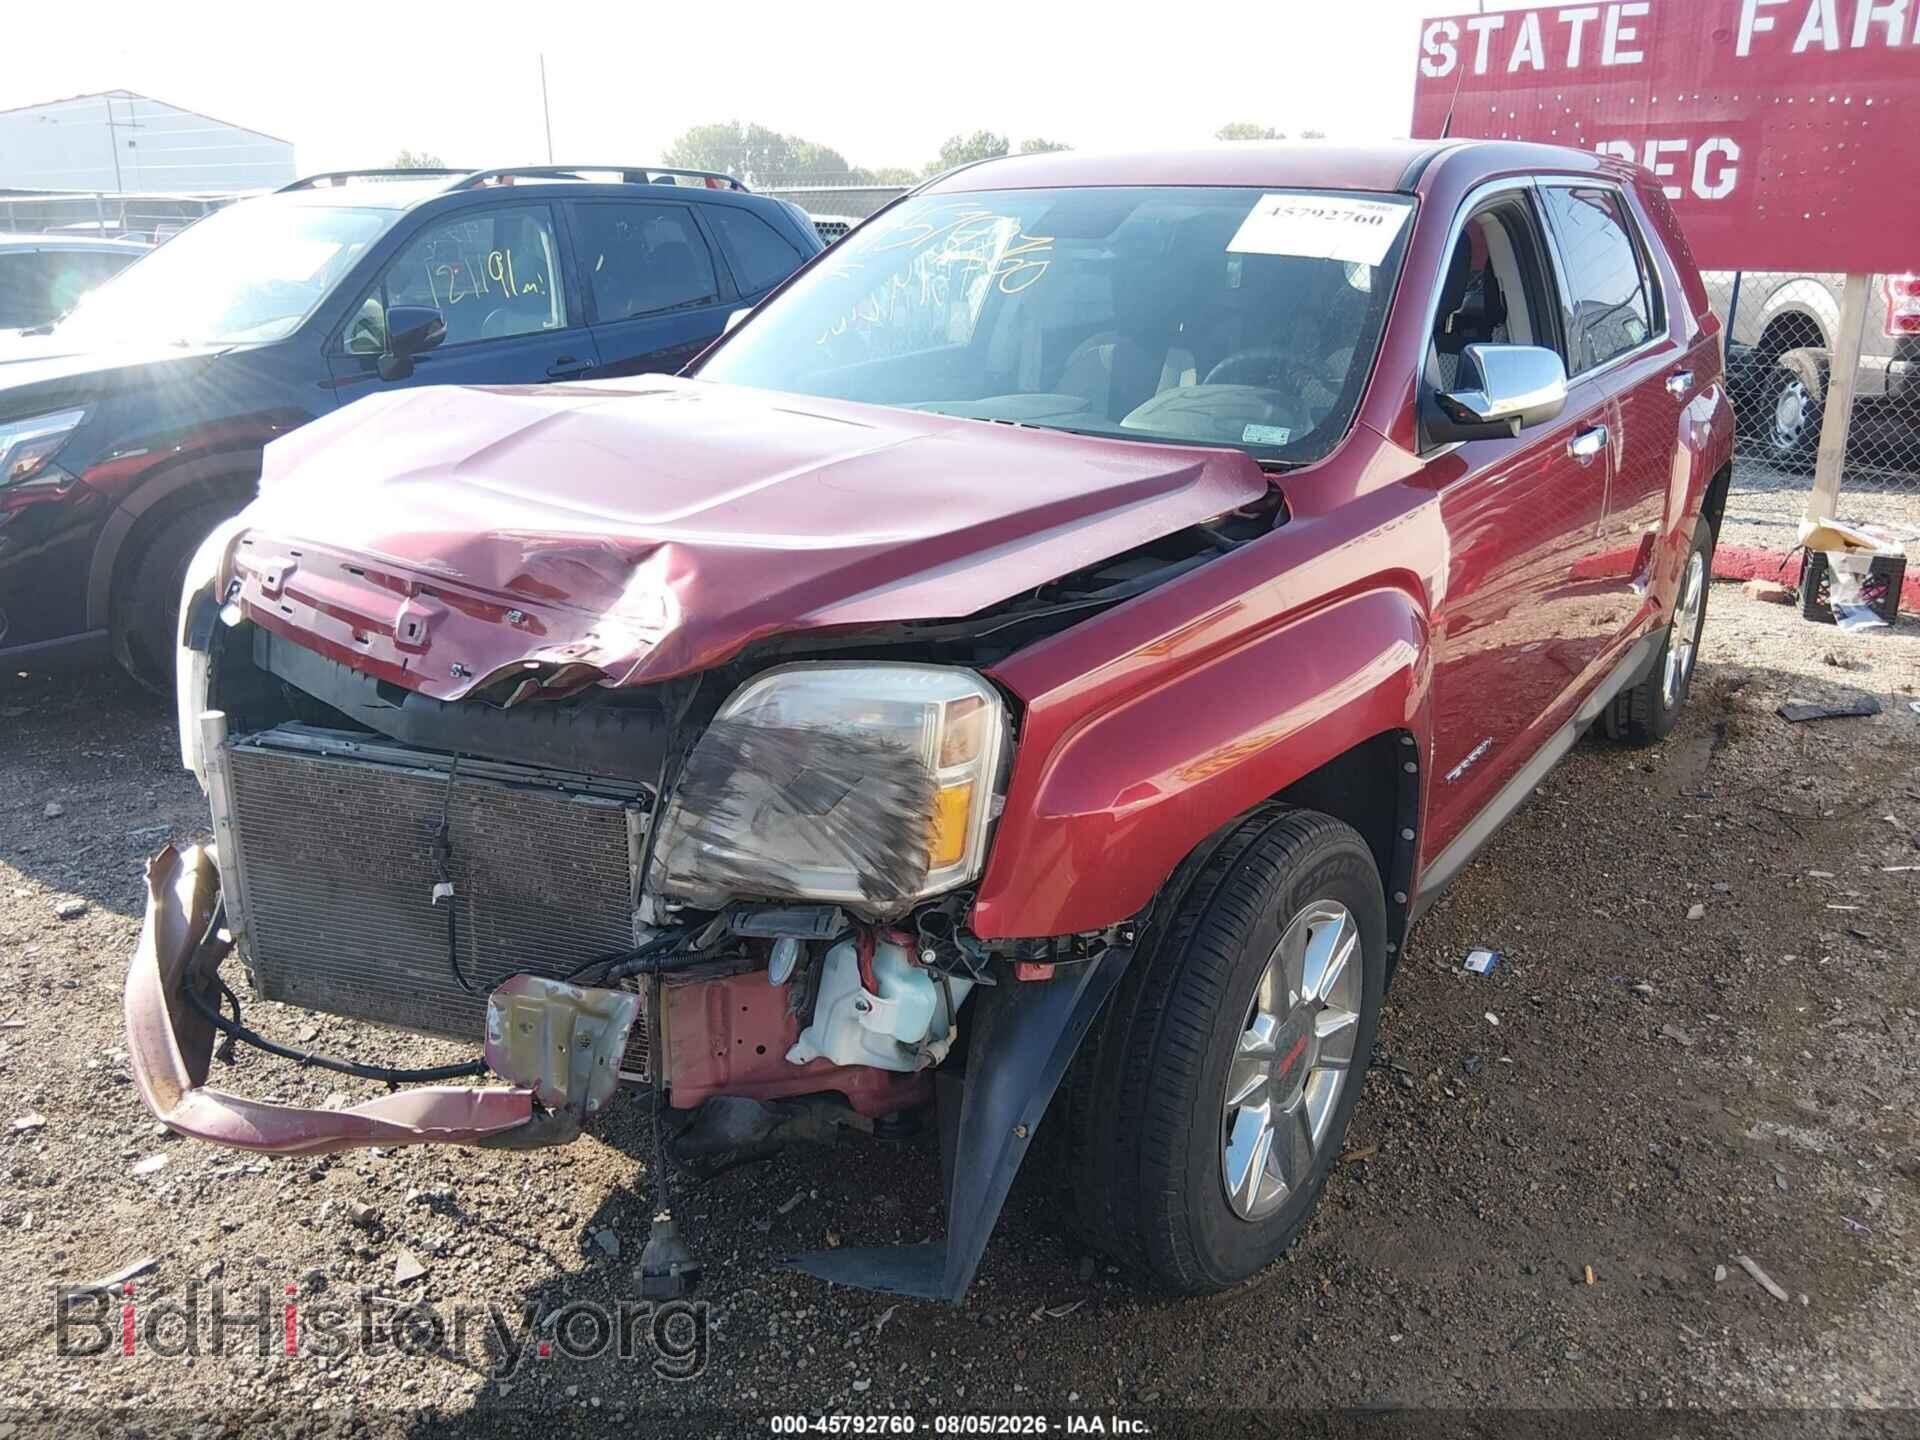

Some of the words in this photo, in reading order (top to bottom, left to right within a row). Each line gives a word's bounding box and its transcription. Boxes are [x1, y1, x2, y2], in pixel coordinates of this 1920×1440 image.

[1420, 3, 1649, 77] STATE
[1735, 0, 1920, 57] FAR
[1595, 137, 1740, 199] EG
